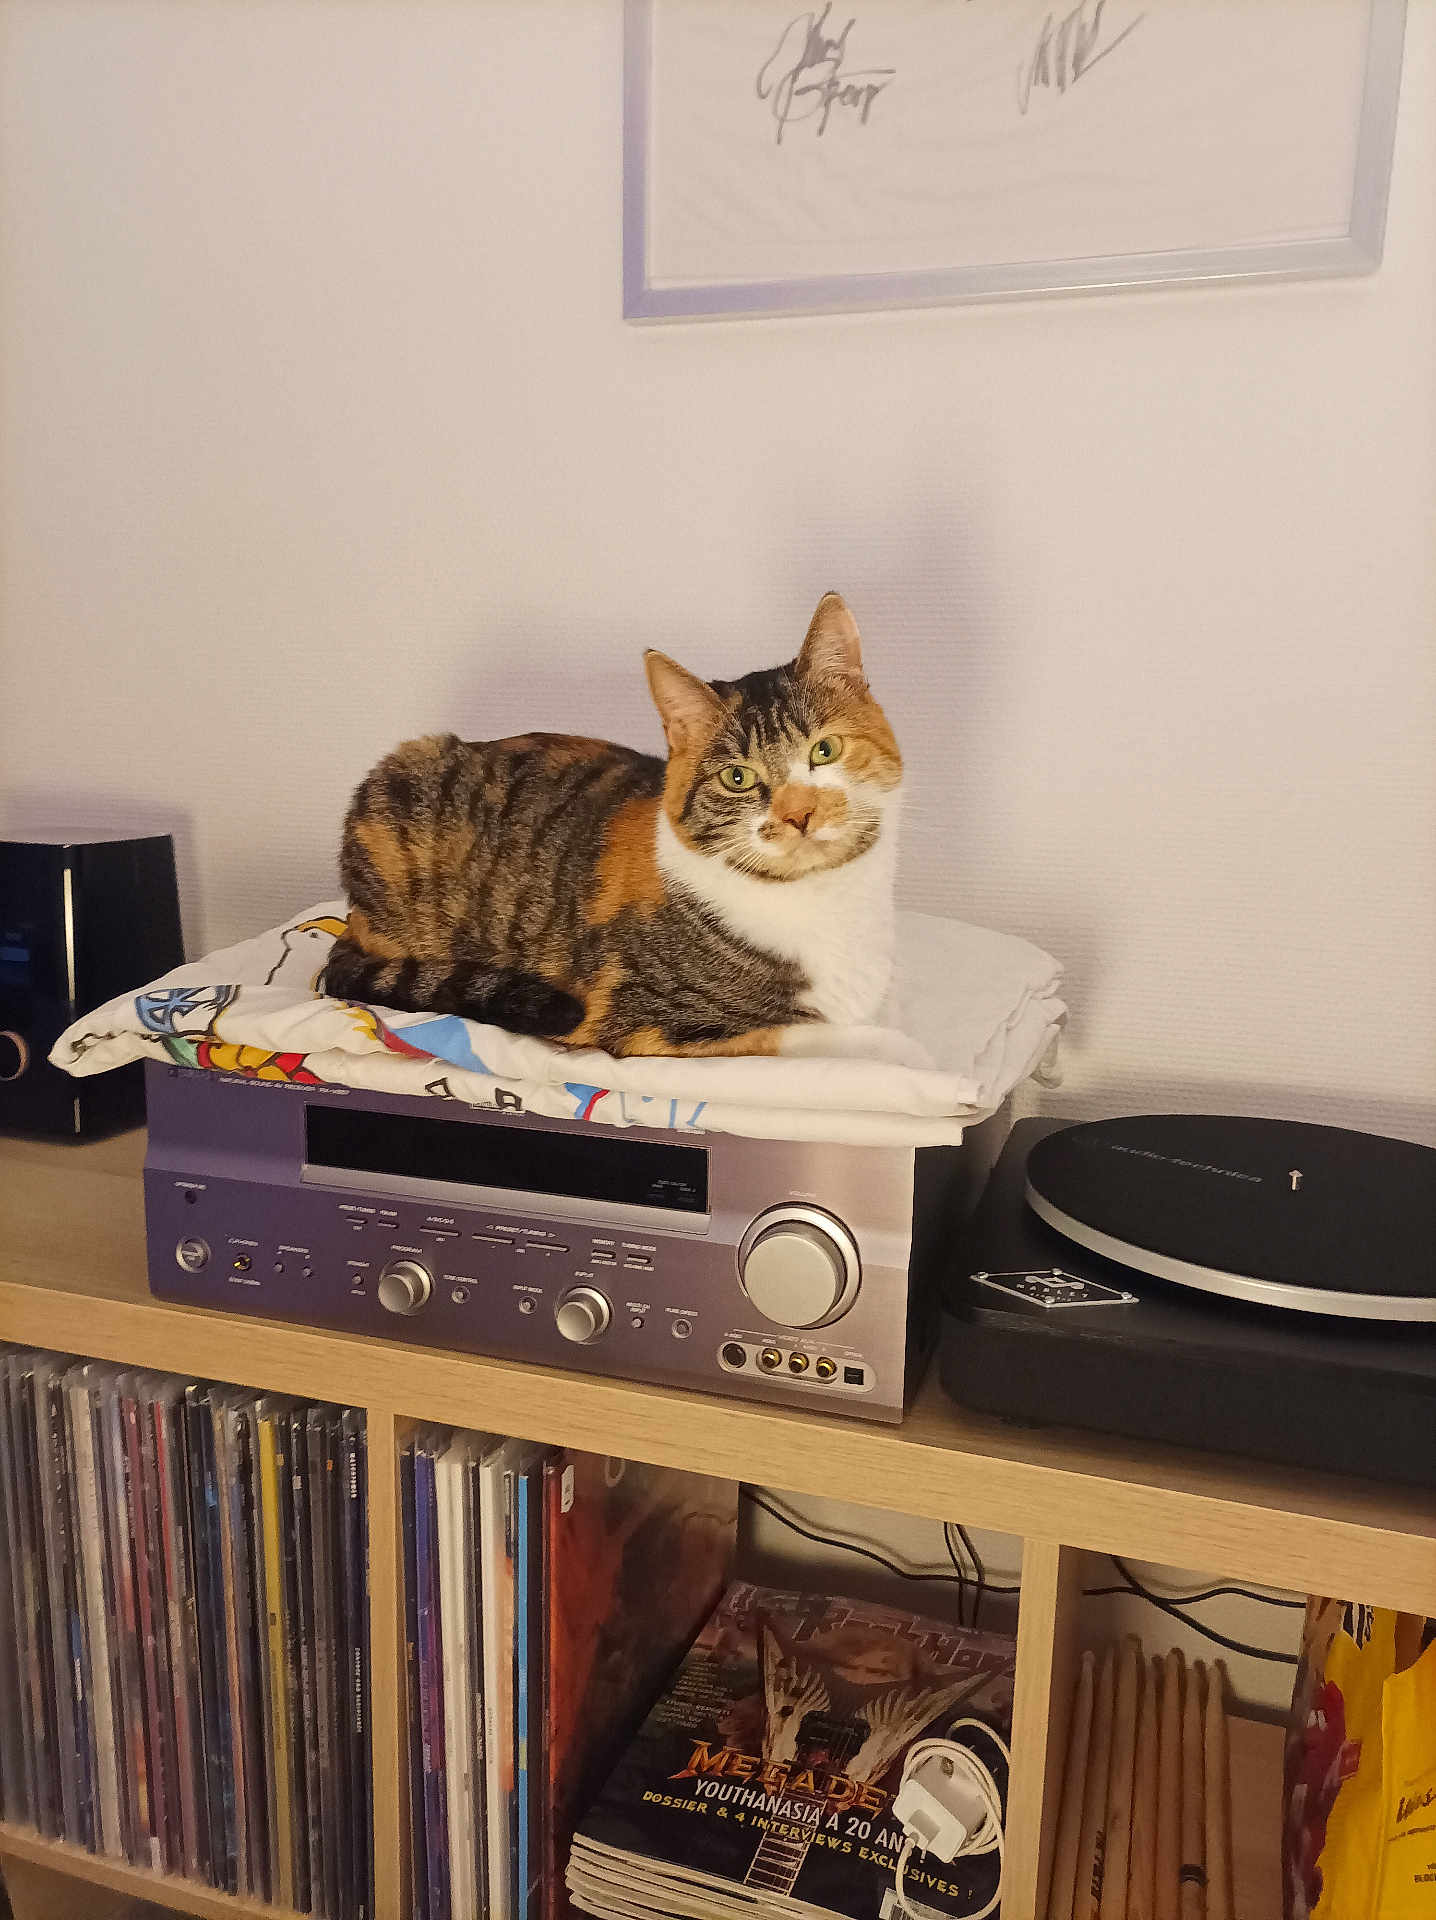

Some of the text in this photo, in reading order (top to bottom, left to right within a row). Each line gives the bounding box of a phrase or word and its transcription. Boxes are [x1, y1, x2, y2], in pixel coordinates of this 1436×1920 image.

[642, 1790, 708, 1815] DOSSIER
[716, 1806, 729, 1819] &
[735, 1811, 746, 1822] 4
[750, 1814, 852, 1855] INTERVIEWS
[693, 1778, 820, 1826] YOUTHANASIA
[825, 1811, 839, 1831] A
[844, 1816, 872, 1840] 20
[874, 1828, 903, 1853] AN
